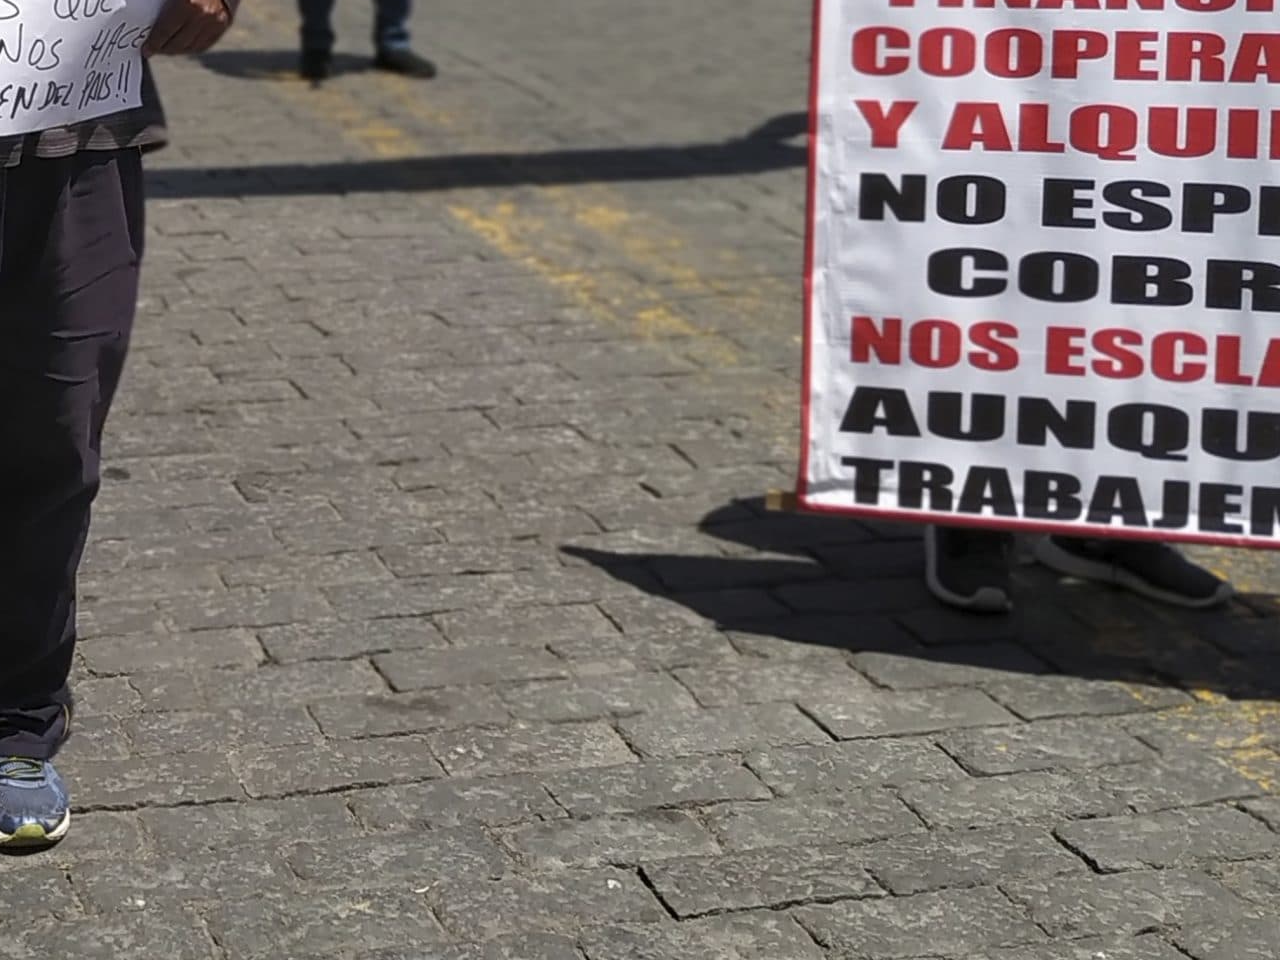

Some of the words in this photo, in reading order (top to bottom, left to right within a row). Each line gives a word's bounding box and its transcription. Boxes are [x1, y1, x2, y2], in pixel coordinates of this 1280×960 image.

[851, 26, 1280, 83] COOPERA
[853, 100, 918, 149] Y
[941, 102, 1280, 161] ALQUI
[858, 172, 1007, 225] NO
[927, 247, 1280, 311] COBR
[850, 316, 1019, 372] NOS
[838, 385, 1280, 462] AUNQU
